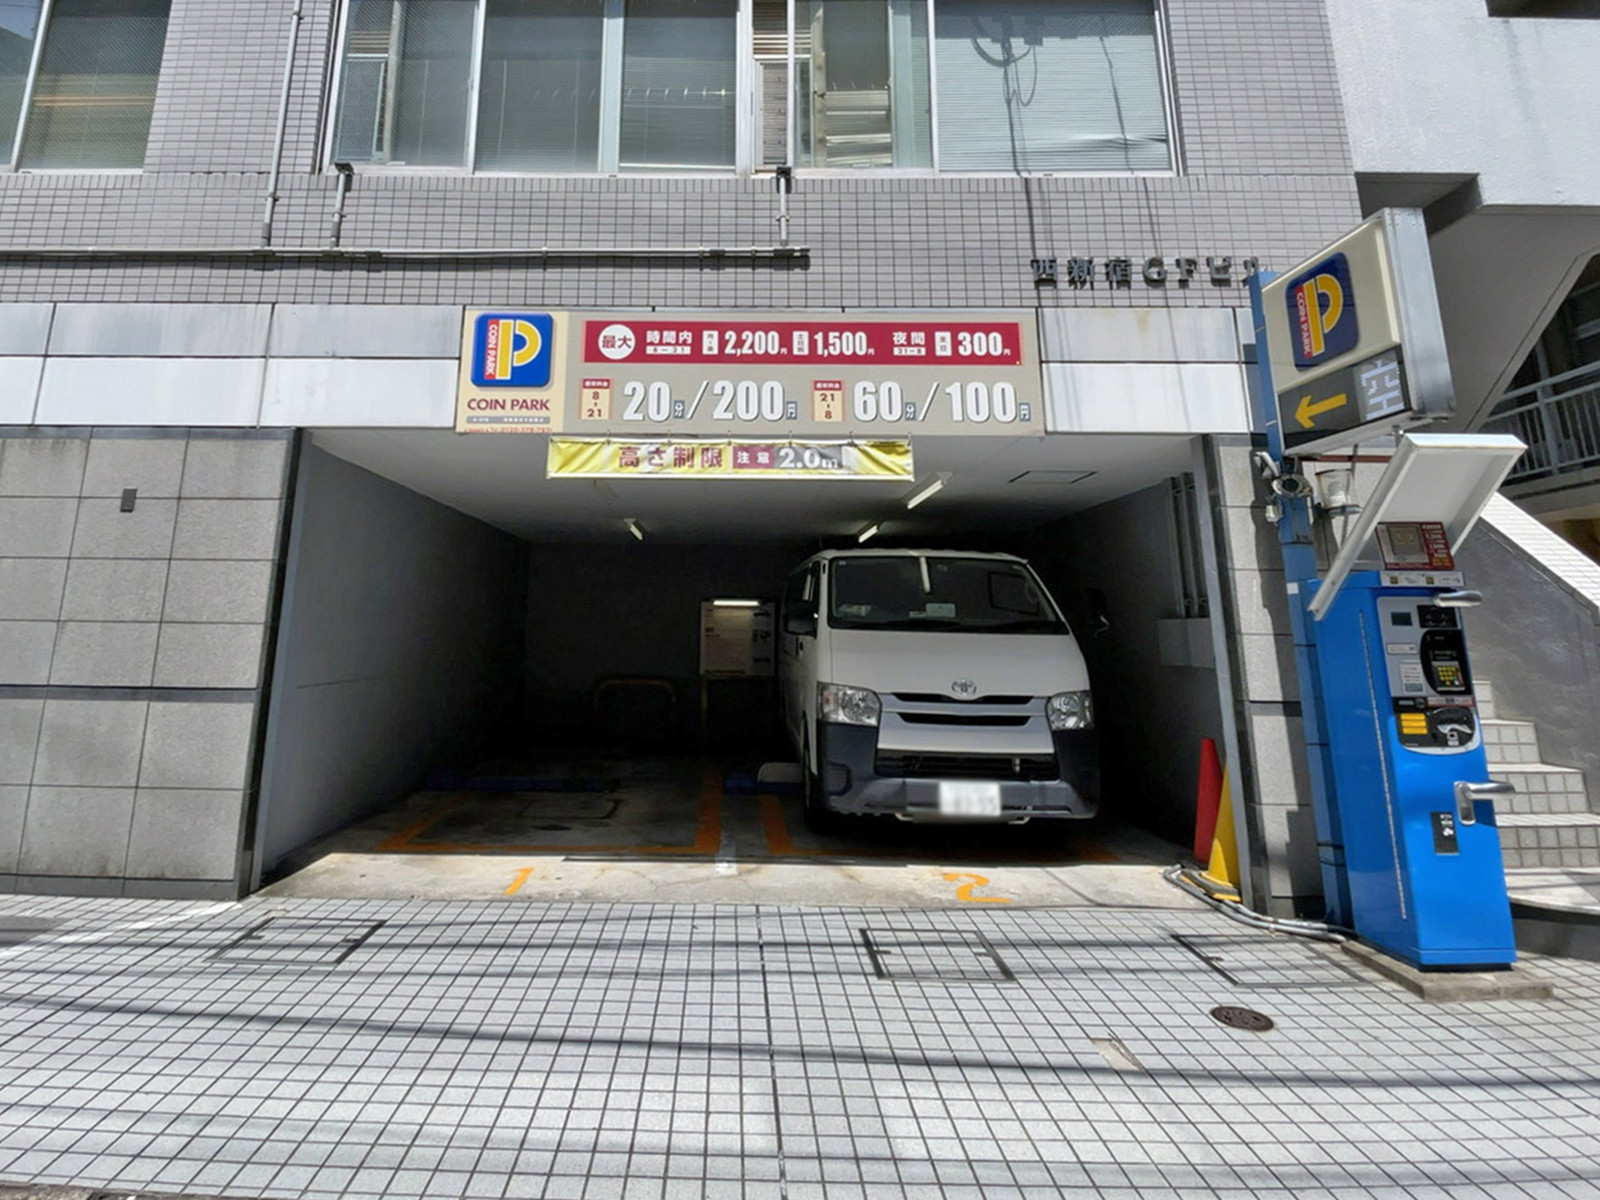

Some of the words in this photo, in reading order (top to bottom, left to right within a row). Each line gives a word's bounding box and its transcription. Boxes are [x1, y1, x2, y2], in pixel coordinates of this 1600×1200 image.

[1296, 291, 1307, 317] COIN
[488, 324, 498, 348] COIN
[601, 335, 633, 349] 最大
[646, 330, 693, 345] 時間内
[725, 331, 788, 357] 2,200円
[813, 331, 875, 358] 1,500円
[892, 331, 926, 345] 夜間
[957, 331, 1012, 356] 300円
[1301, 323, 1312, 355] PARK
[486, 350, 497, 376] PARK
[467, 398, 506, 411] COIN
[510, 398, 551, 411] PARK
[618, 445, 723, 469] 高さ制限
[737, 450, 771, 465] 注意
[778, 447, 839, 469] 2.0m
[503, 867, 534, 895] 1
[942, 872, 1011, 905] 2
